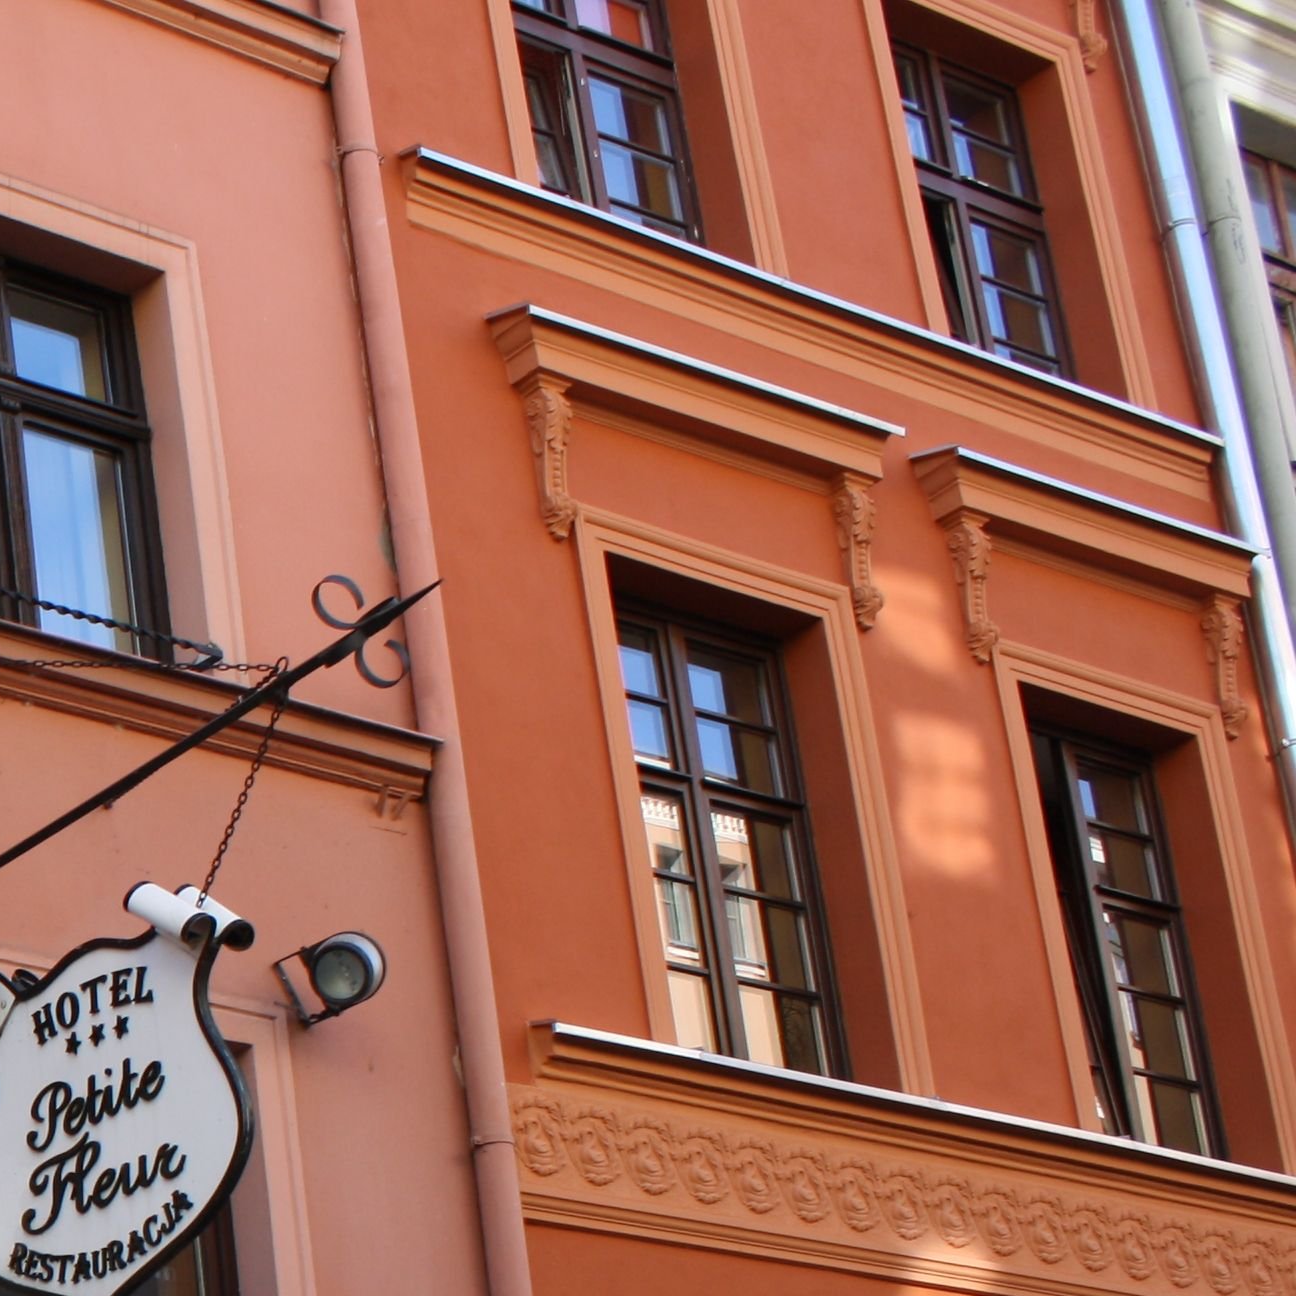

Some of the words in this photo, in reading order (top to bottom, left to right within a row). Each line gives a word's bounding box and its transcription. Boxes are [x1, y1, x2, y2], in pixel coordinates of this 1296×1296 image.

[31, 966, 154, 1046] HOTEL
[26, 1058, 166, 1152] Petite
[21, 1132, 187, 1236] Fleur
[9, 1189, 194, 1285] RESTAURACJA
